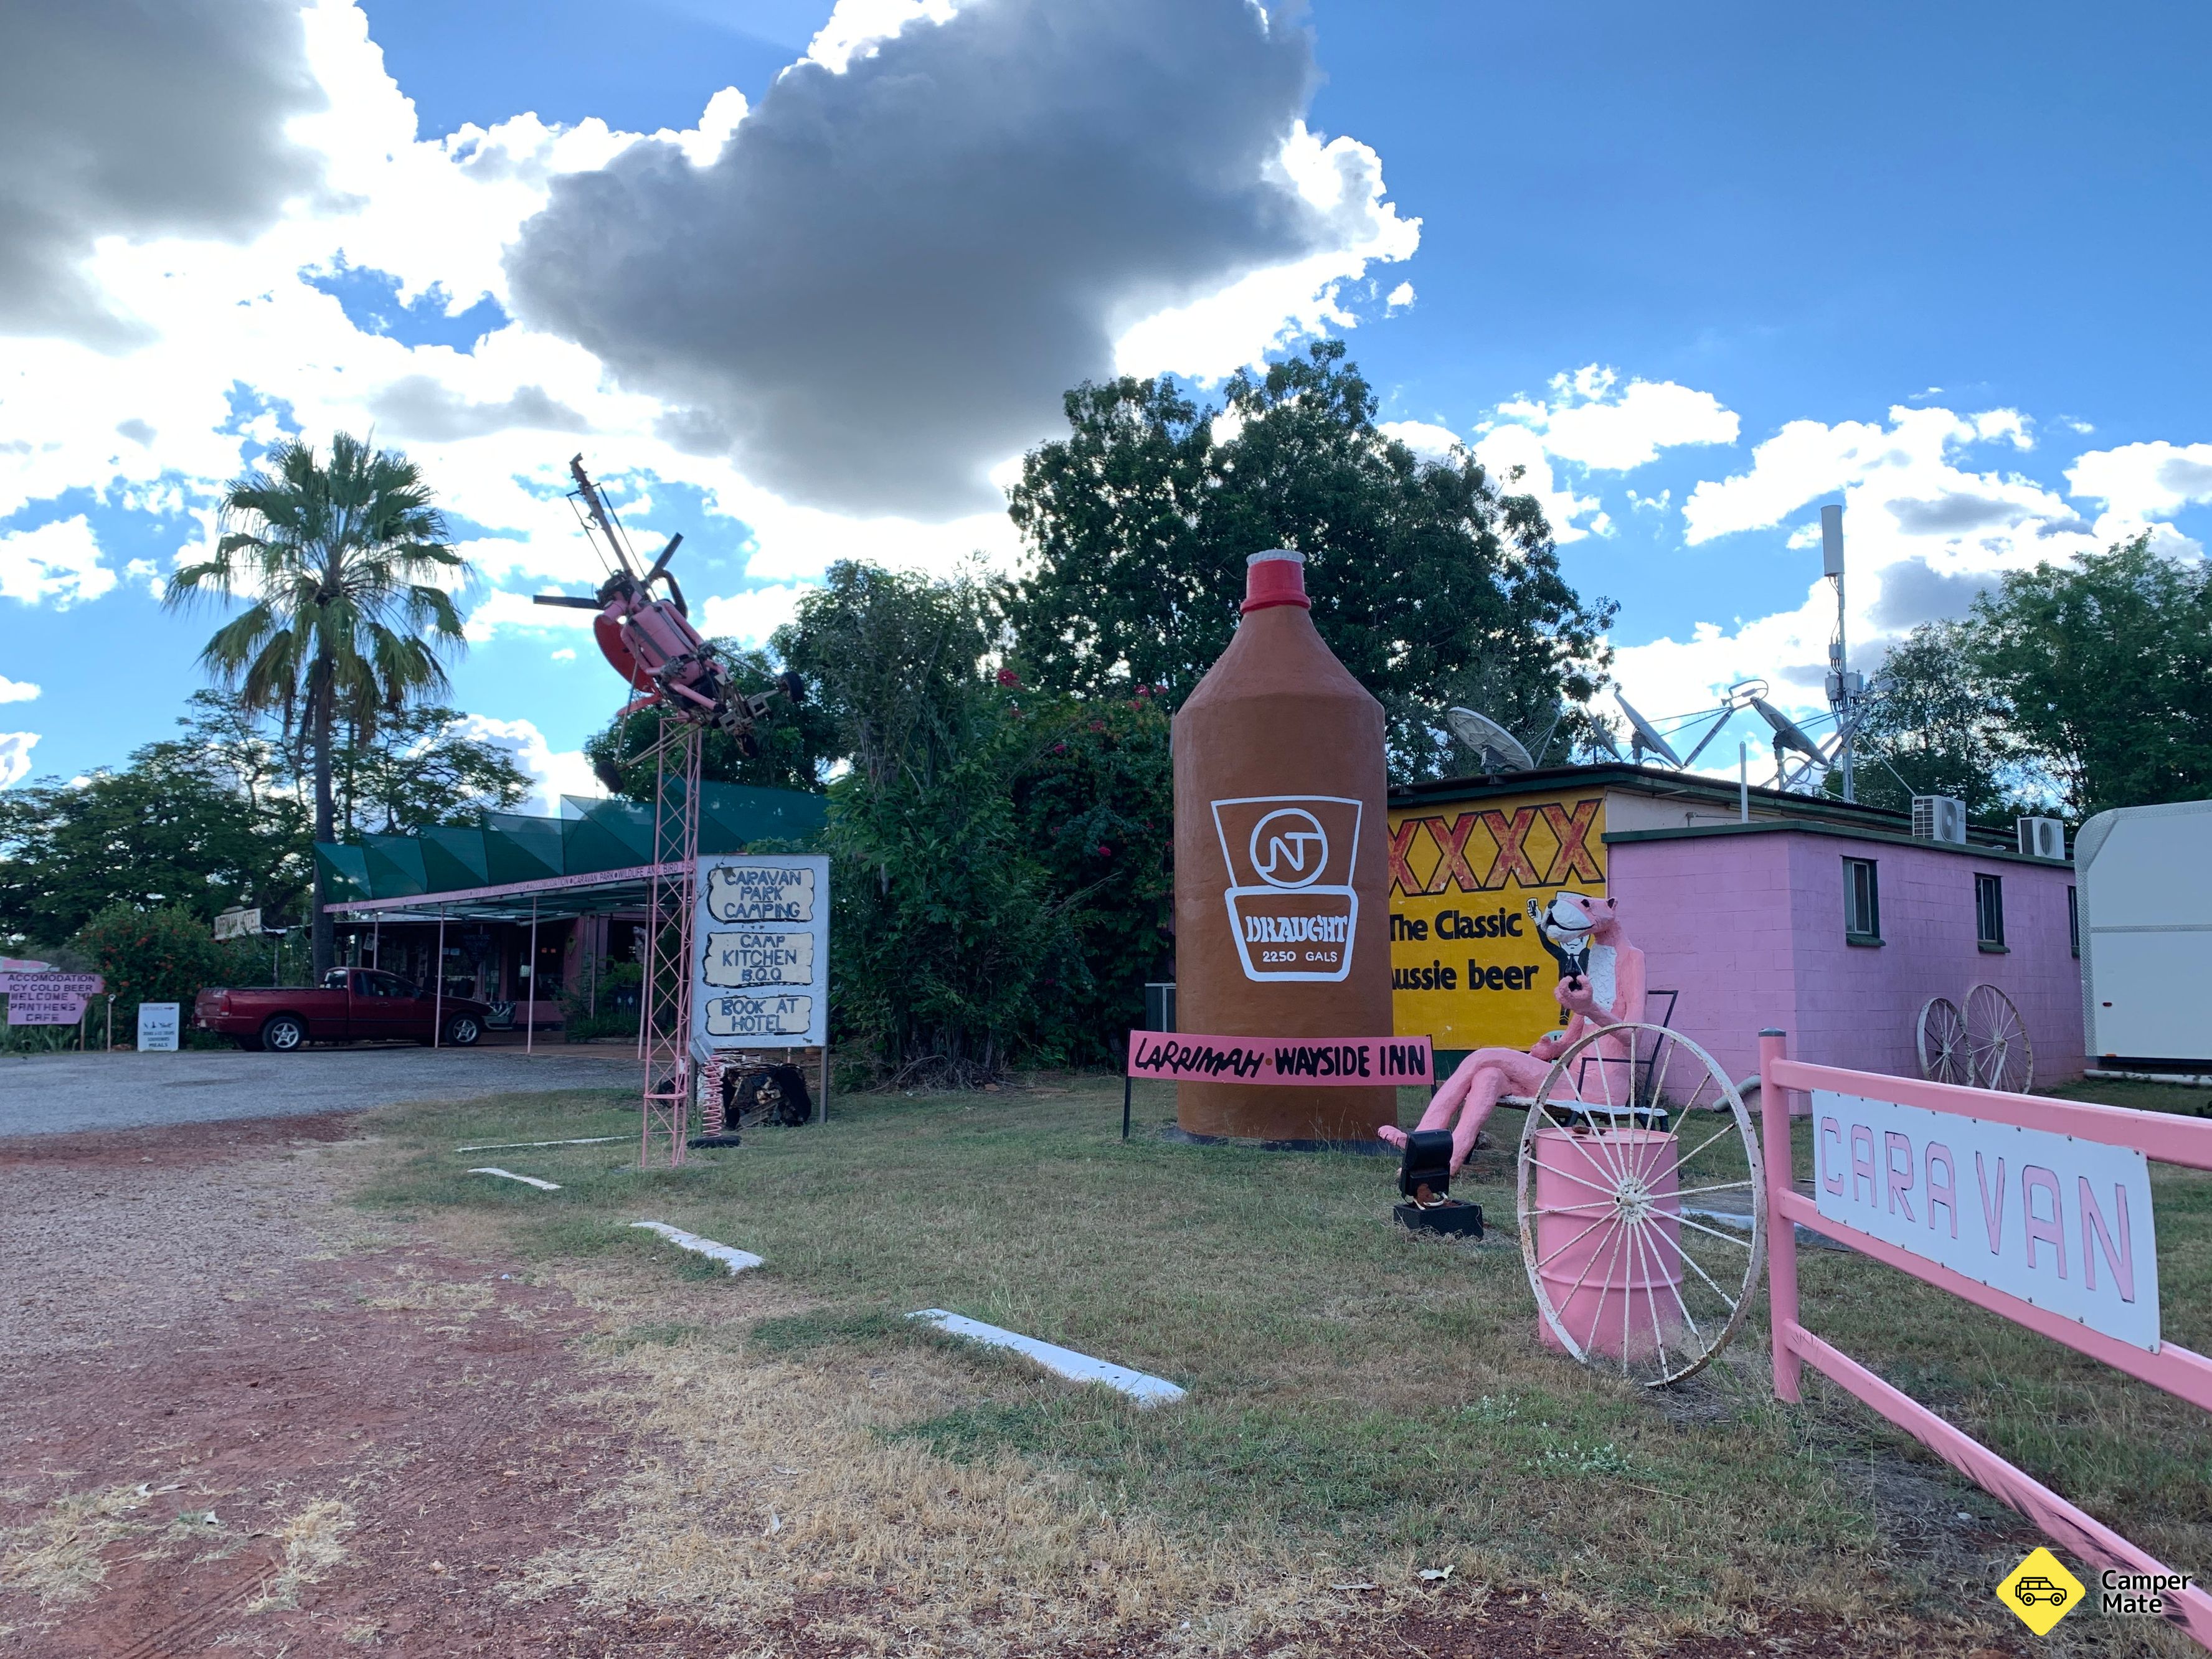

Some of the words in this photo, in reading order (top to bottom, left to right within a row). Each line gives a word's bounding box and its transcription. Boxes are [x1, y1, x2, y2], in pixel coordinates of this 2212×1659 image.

[573, 873, 597, 884] CARAVAN
[600, 871, 614, 882] PARK
[618, 867, 643, 879] WILDLIFE
[663, 863, 678, 872] BIRD
[724, 871, 801, 886] CARAVAN
[740, 886, 784, 900] PARK
[724, 902, 800, 918] CAMPING
[1245, 915, 1348, 943] DRAUGHT
[1389, 913, 1428, 942] The
[1435, 907, 1523, 940] Classic
[740, 935, 785, 948] CAMP
[722, 949, 797, 966] KITCHEN
[1262, 951, 1296, 962] 2250
[1305, 952, 1338, 962] GALS
[1391, 960, 1457, 991] ussie
[1468, 958, 1539, 990] beer
[31, 984, 60, 992] COLD
[11, 993, 69, 1001] WELCOME
[722, 999, 765, 1016] BOOK
[777, 998, 799, 1013] AT
[732, 1015, 787, 1031] HOTEL
[1135, 1037, 1265, 1078] LARRIMAH
[1274, 1046, 1370, 1078] WAYSIDE
[1380, 1045, 1425, 1076] INN
[1821, 1117, 2135, 1303] CARAVAN
